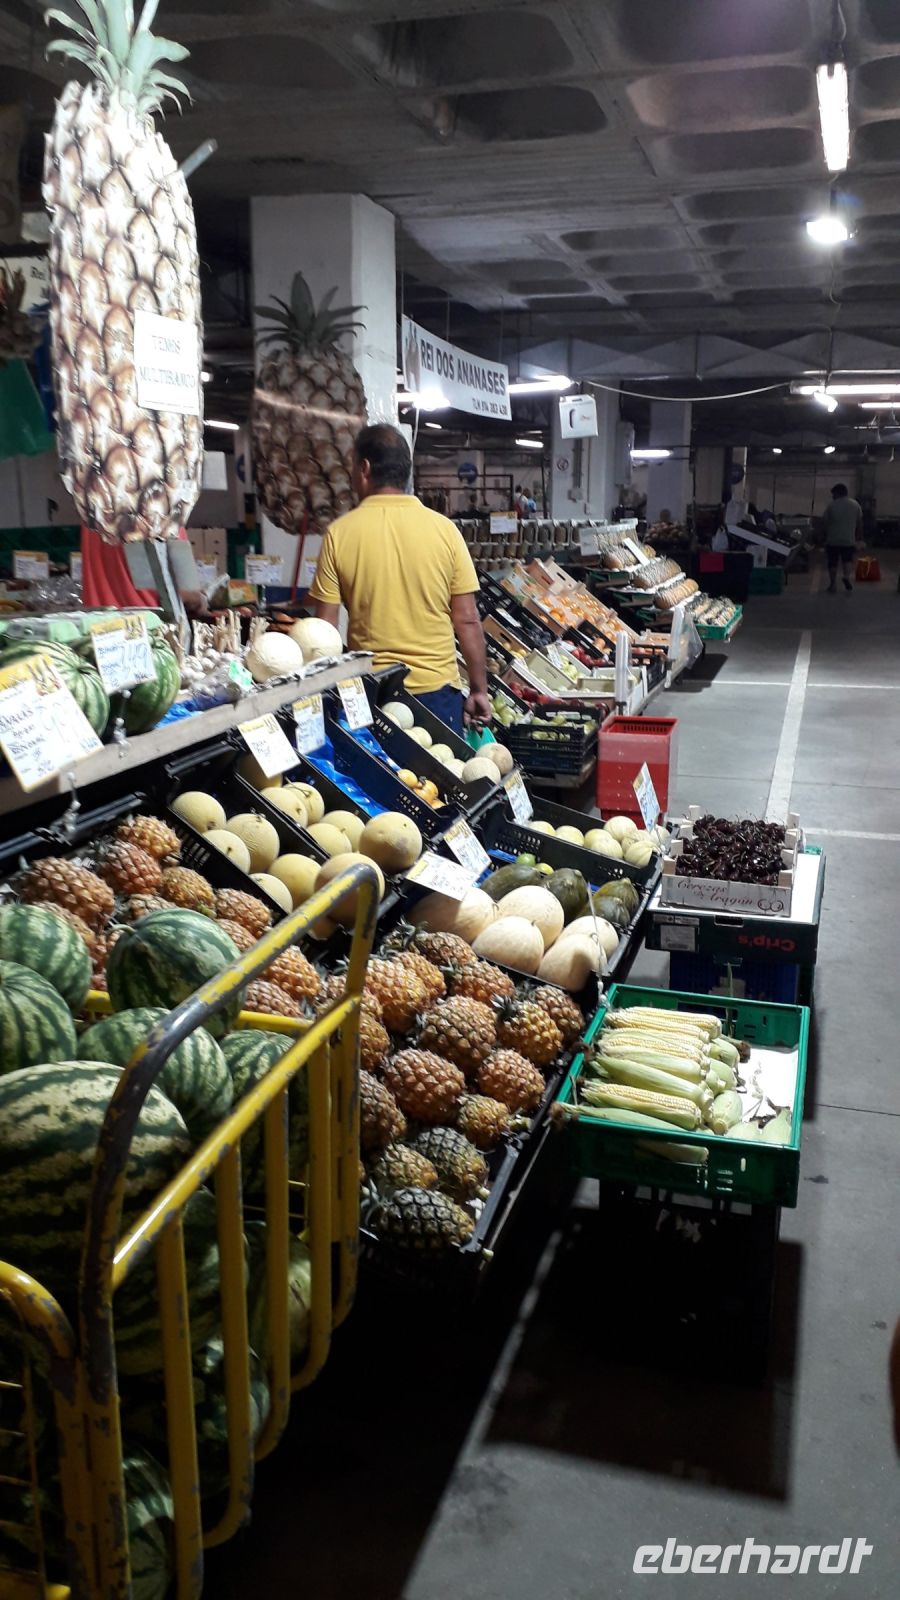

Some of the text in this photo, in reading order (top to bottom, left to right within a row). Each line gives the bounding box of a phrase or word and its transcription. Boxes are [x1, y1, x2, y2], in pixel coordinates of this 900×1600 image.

[139, 366, 196, 388] MULTIBANCO
[420, 339, 505, 396] REI DOS ANANASES
[678, 879, 727, 893] Cerezas
